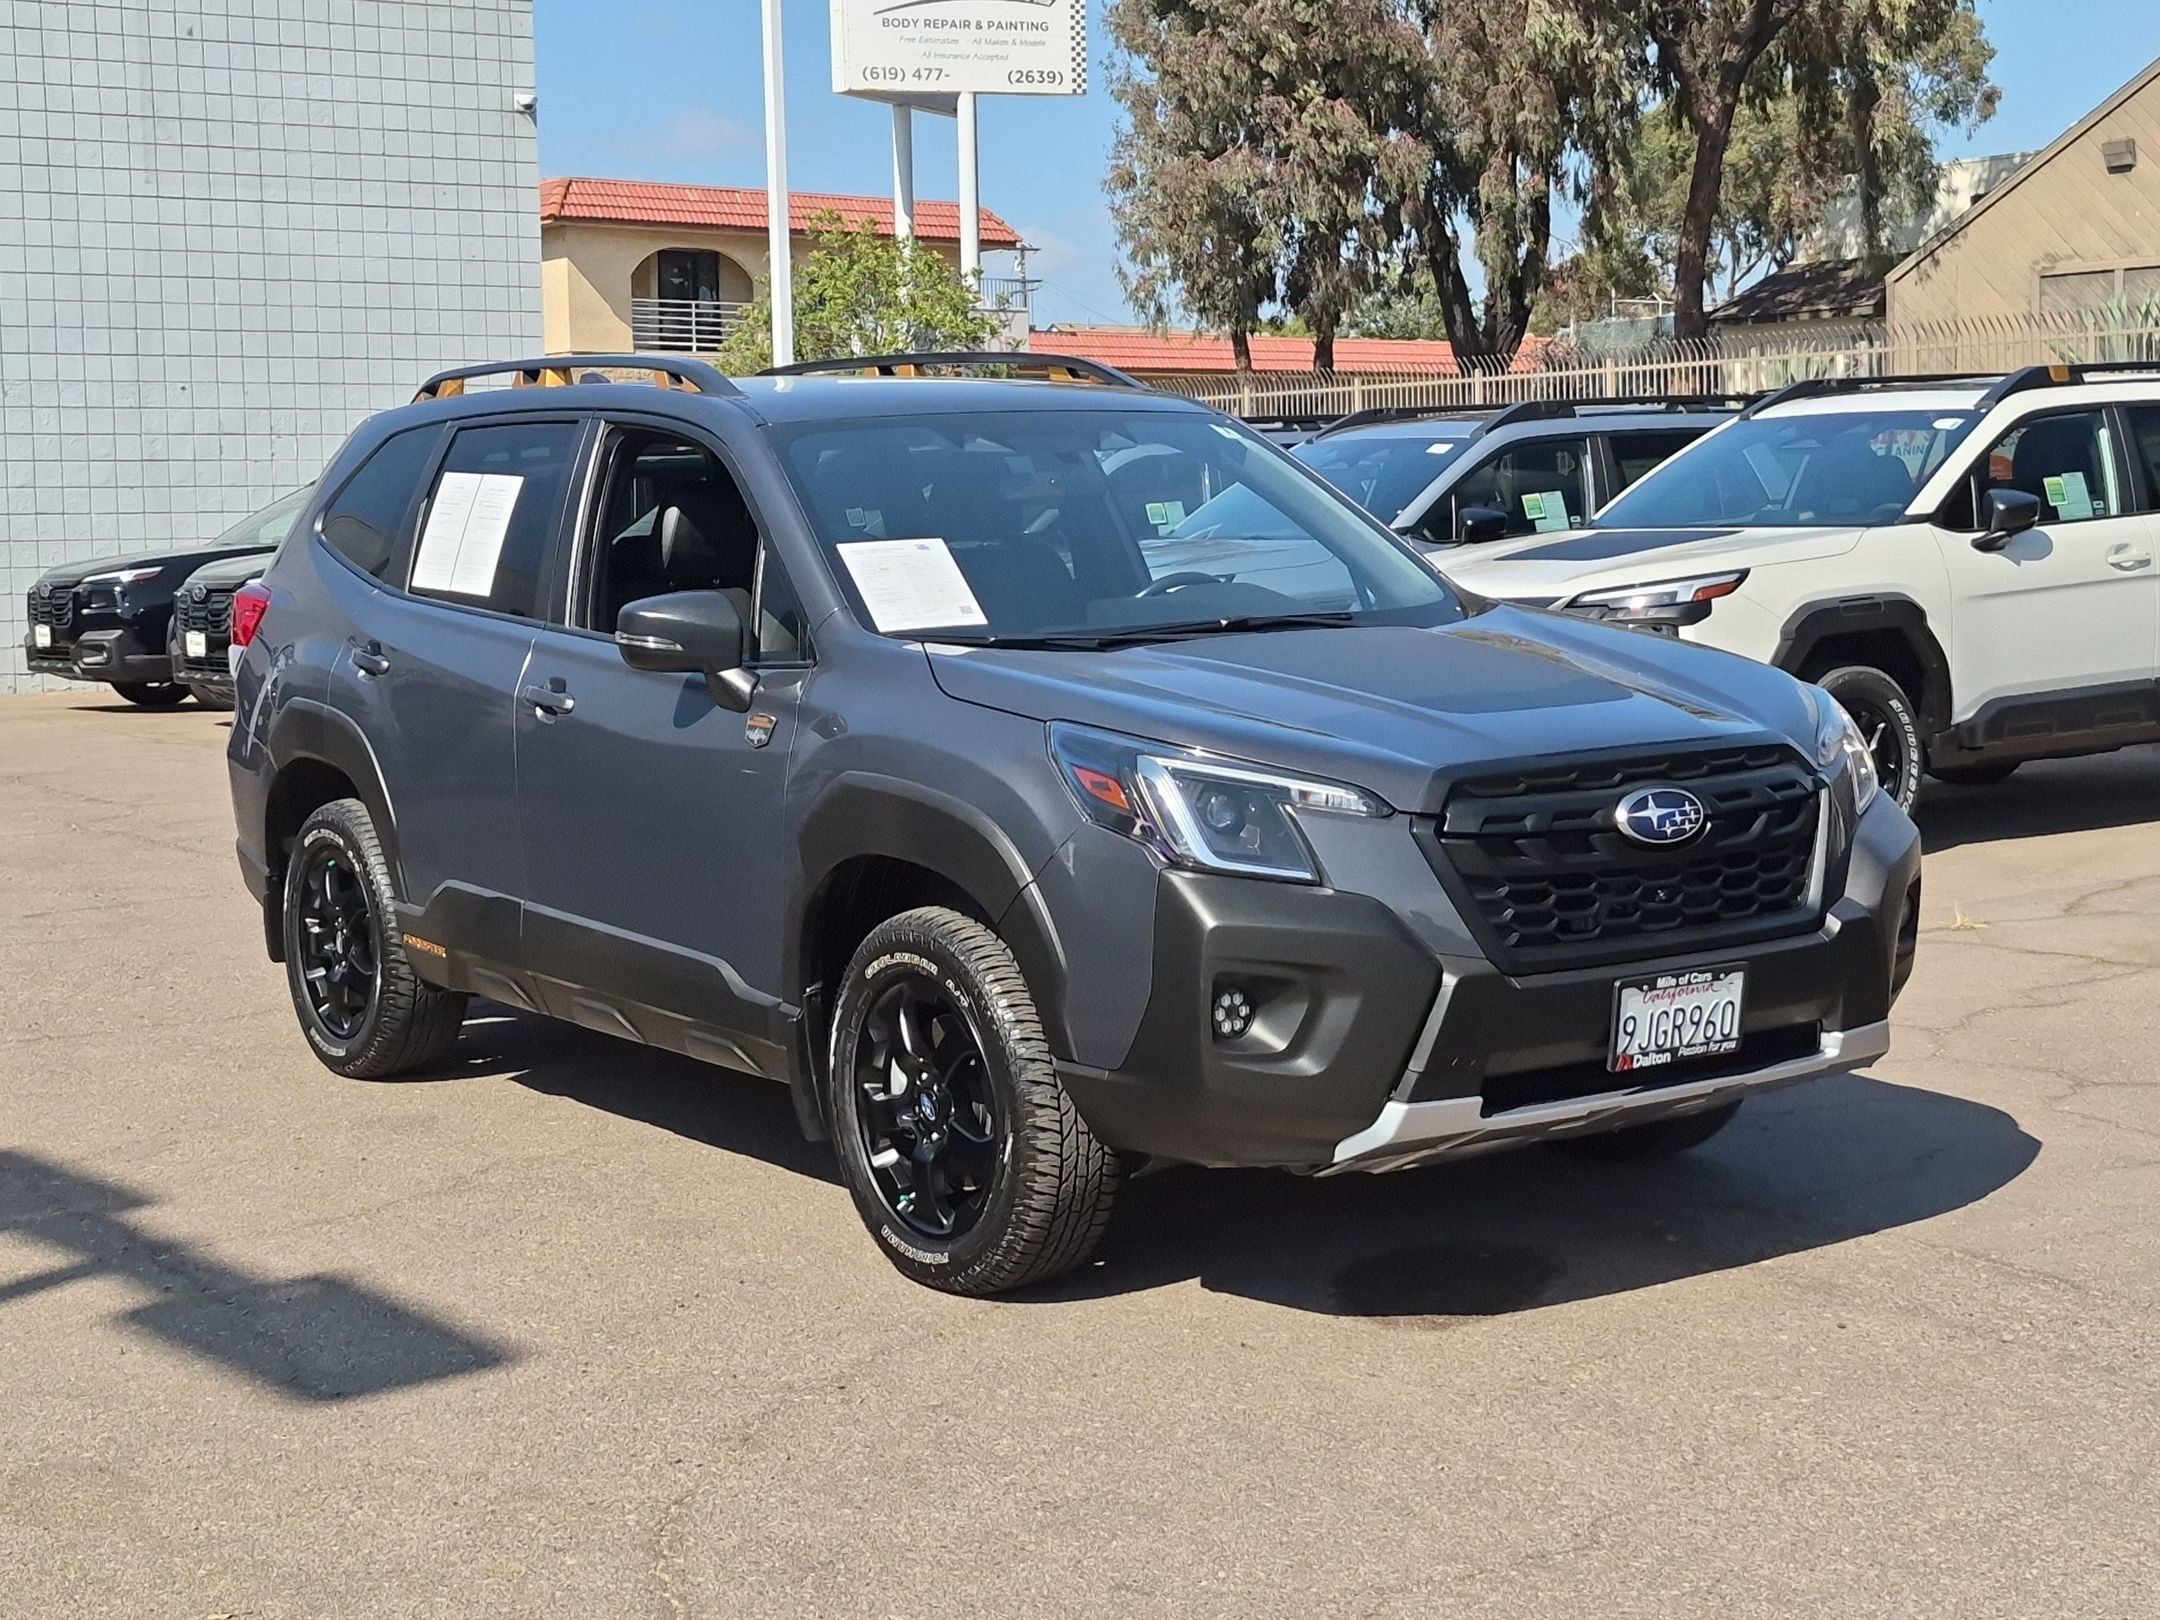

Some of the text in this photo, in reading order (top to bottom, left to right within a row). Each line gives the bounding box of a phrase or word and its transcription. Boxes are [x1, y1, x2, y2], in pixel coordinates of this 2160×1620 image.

[882, 18, 1049, 32] BODY REPAIR & PAINTING
[899, 36, 959, 45] Free Estimates
[972, 38, 982, 46] All
[1020, 39, 1046, 47] Models
[921, 51, 1009, 62] All Insurance Accepted
[862, 66, 951, 82] (619) 477-
[1007, 70, 1064, 85] (2639)
[1656, 972, 1712, 988] Mile of Cars
[1642, 982, 1722, 1005] California
[1622, 1000, 1735, 1054] 9JGR960
[1678, 1040, 1737, 1057] Passion for you
[1633, 1051, 1671, 1069] Dalton
